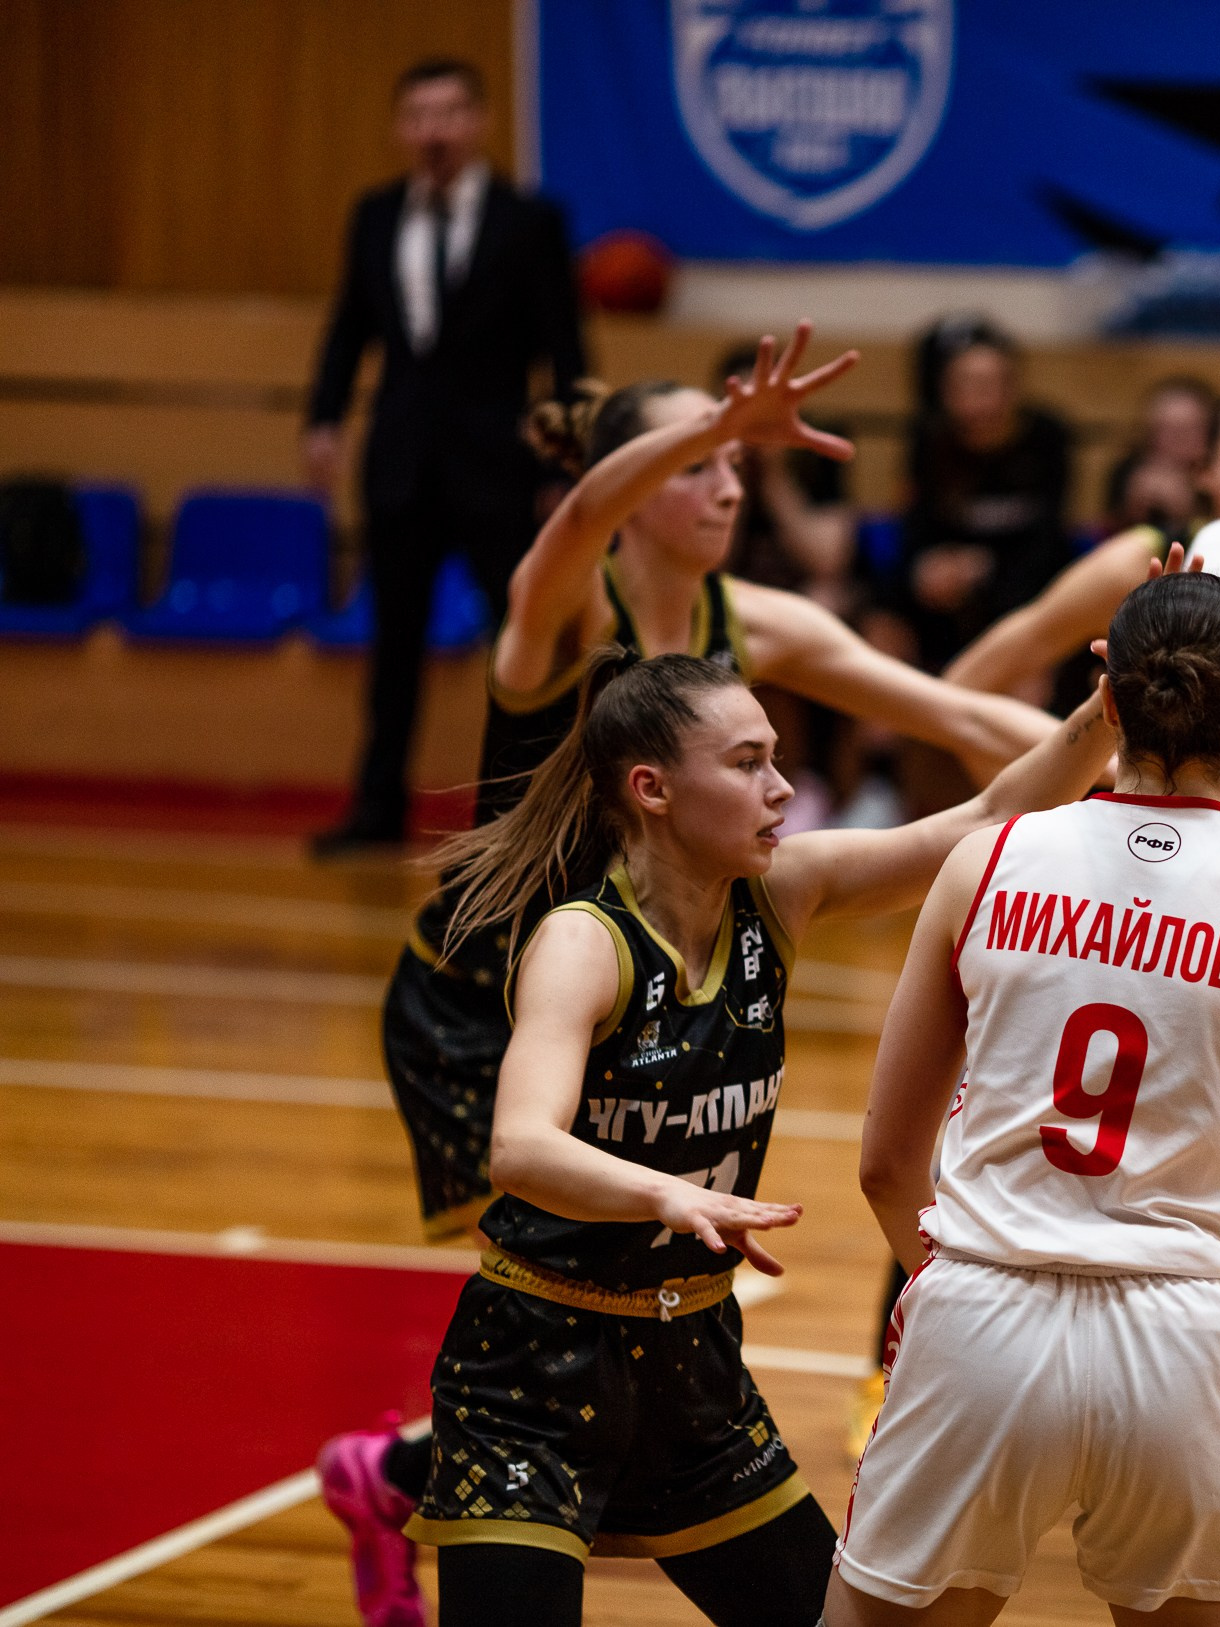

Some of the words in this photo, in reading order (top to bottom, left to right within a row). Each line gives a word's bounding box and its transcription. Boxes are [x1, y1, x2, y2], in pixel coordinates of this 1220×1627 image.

[1134, 835, 1176, 853] РФБ
[632, 1048, 677, 1068] ATLANTA
[1039, 1002, 1148, 1177] 9
